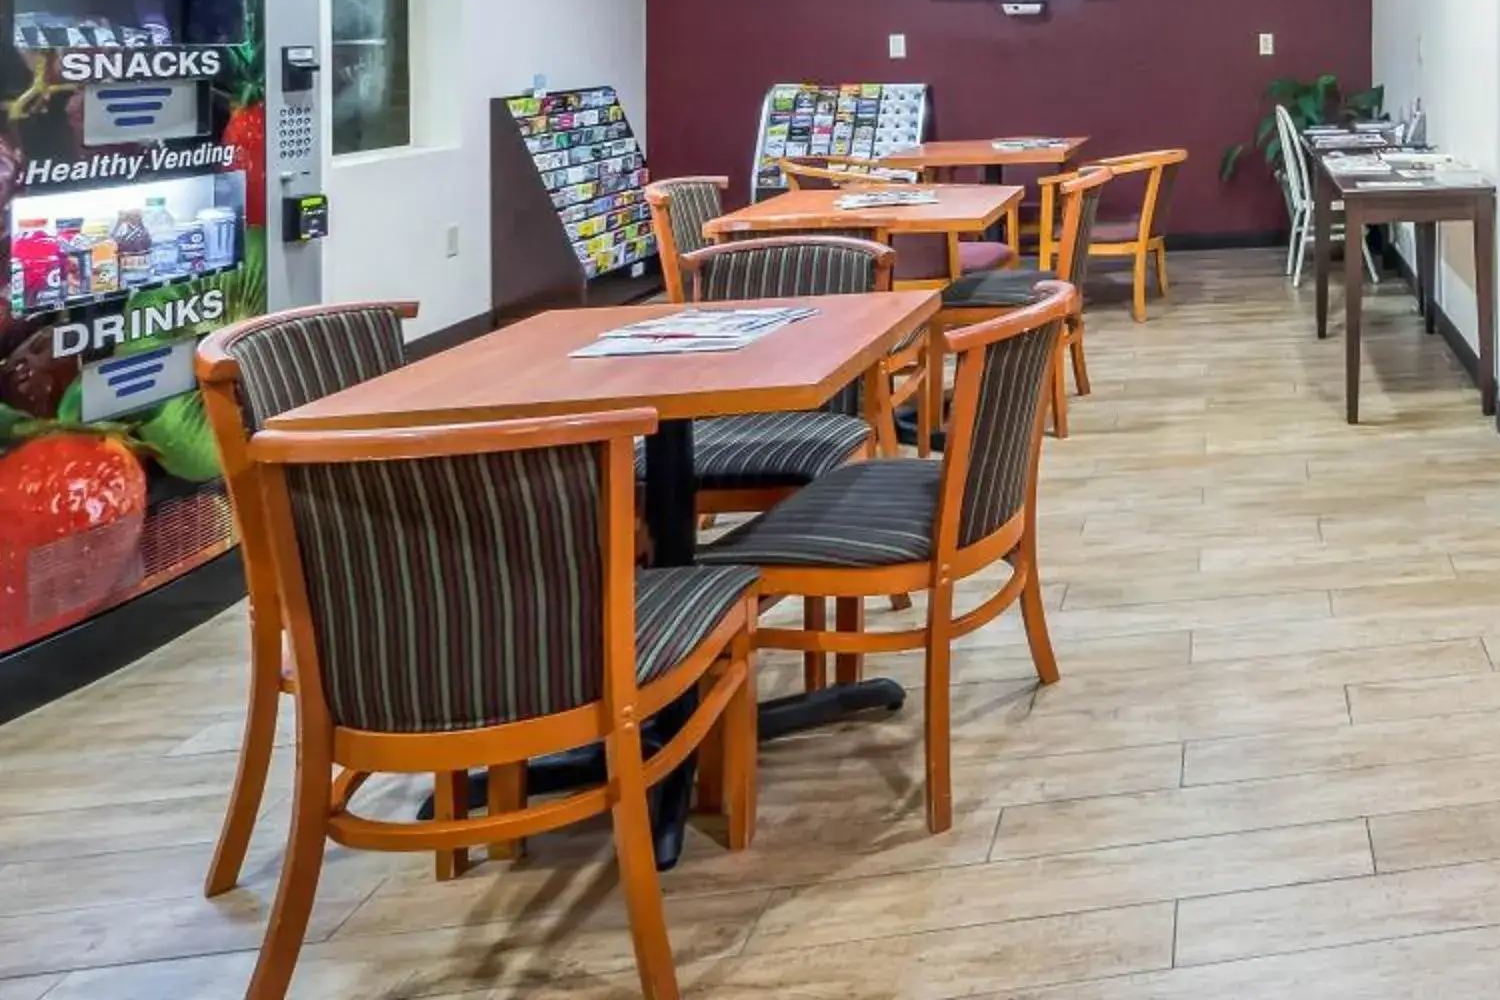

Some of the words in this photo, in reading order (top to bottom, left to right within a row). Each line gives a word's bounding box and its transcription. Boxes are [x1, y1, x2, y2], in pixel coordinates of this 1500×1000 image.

[60, 50, 221, 82] SNACKS
[25, 152, 144, 185] Healthy
[150, 143, 235, 172] Vending
[52, 289, 225, 358] DRINKS
